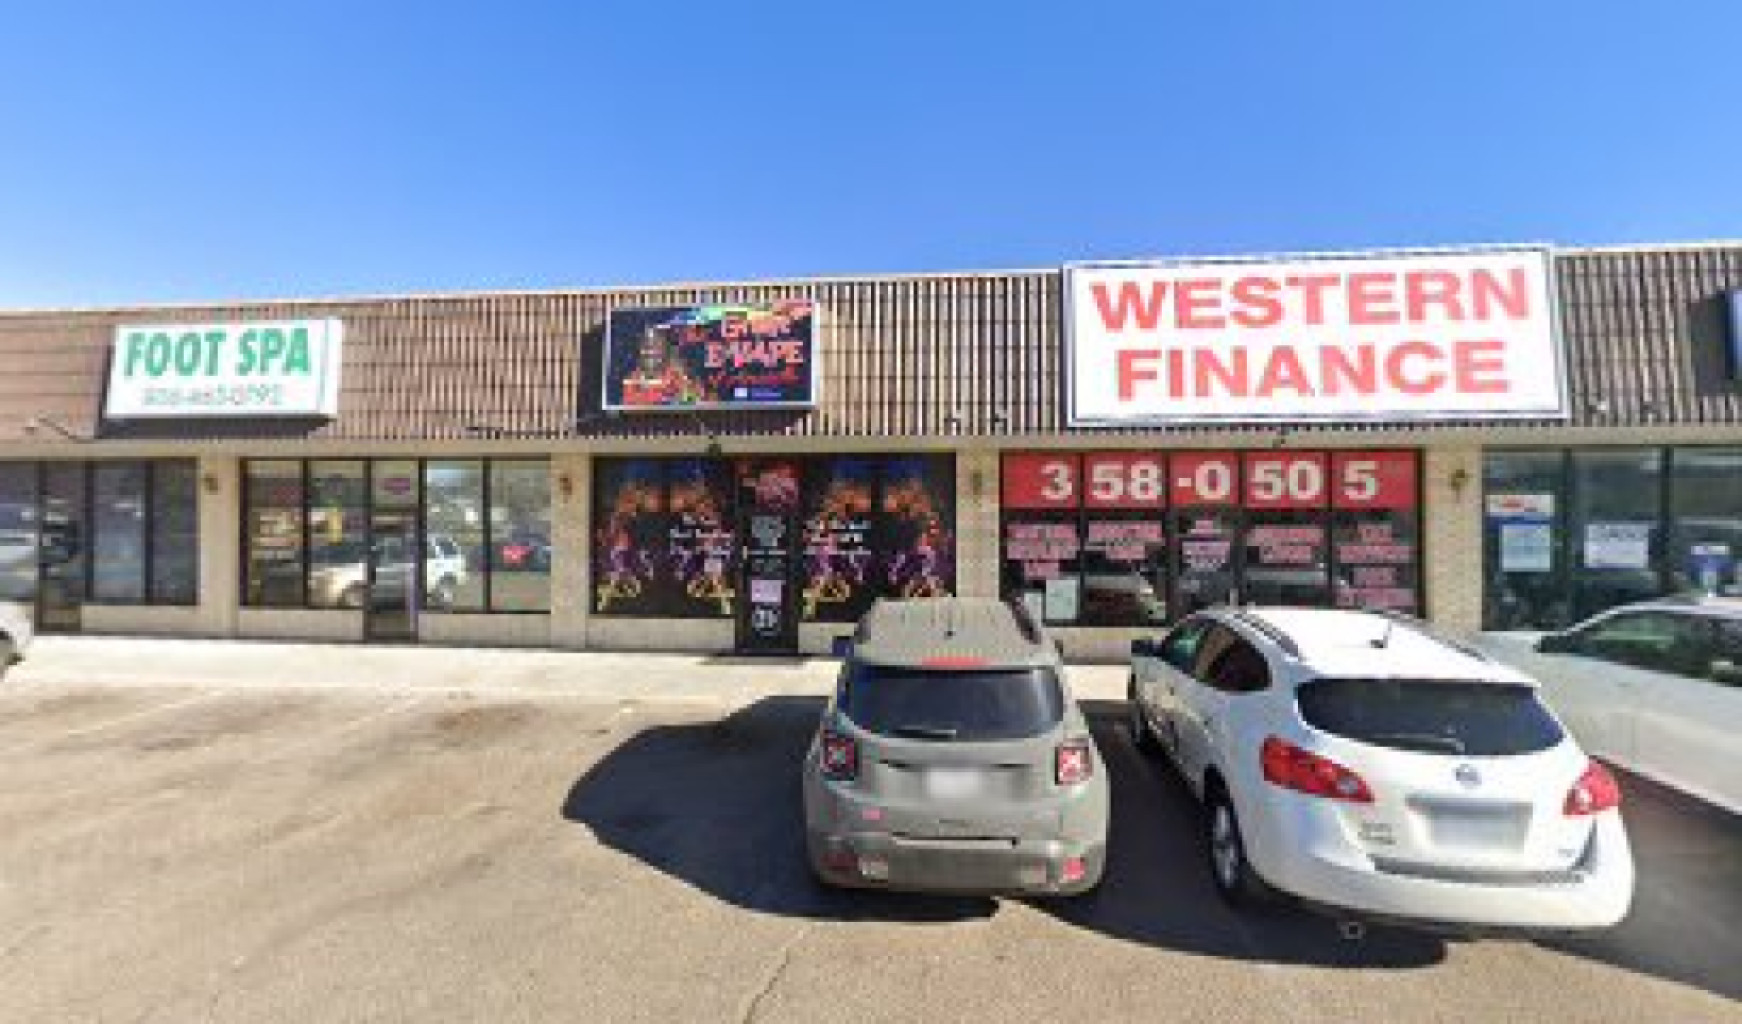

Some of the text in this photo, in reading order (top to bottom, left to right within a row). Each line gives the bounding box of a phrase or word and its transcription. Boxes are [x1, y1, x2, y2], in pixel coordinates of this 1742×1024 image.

[1089, 267, 1531, 331] WESTERN
[124, 327, 310, 377] FOOT SPA
[1114, 339, 1511, 402] FINANCE
